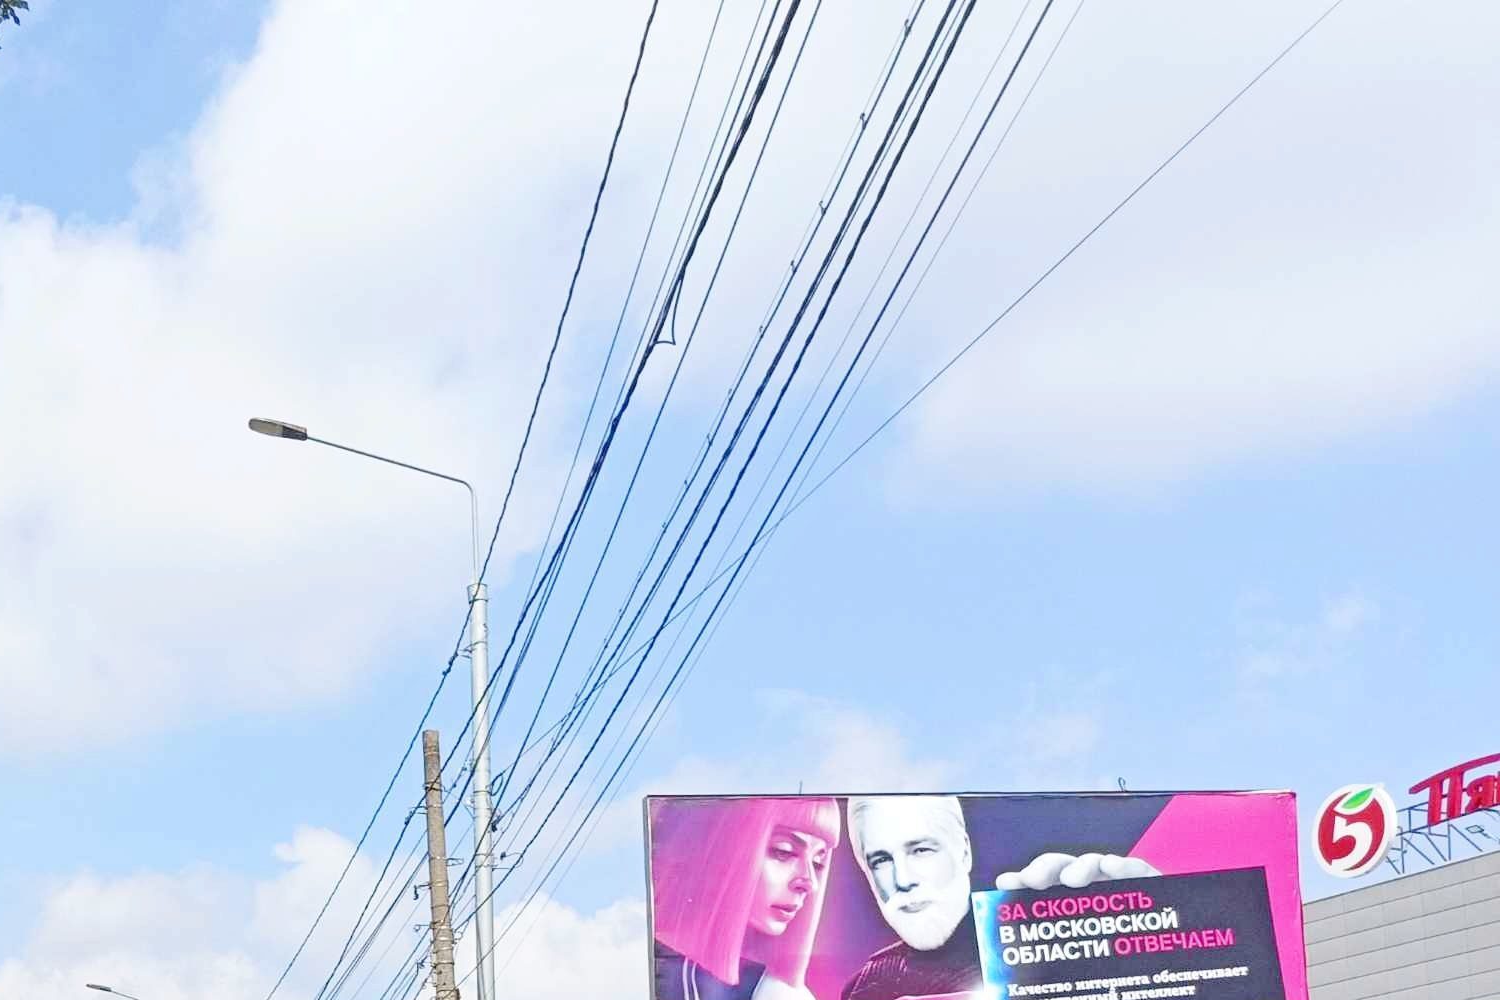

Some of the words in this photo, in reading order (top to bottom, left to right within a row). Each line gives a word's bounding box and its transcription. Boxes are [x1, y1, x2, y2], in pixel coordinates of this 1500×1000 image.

[1409, 753, 1500, 826] Пя
[999, 903, 1027, 921] ЗА
[1032, 892, 1152, 918] СКОРОСТЬ
[1000, 925, 1015, 943] В
[1020, 907, 1178, 941] МОСКОВСКОЙ
[1003, 938, 1109, 965] ОБЛАСТИ
[1114, 928, 1233, 954] ОТВЕЧАЕМ
[1008, 981, 1072, 997] Качество
[1076, 974, 1149, 992] интернета
[1153, 966, 1248, 984] обеспечивает
[1122, 984, 1195, 1000] интеллект
